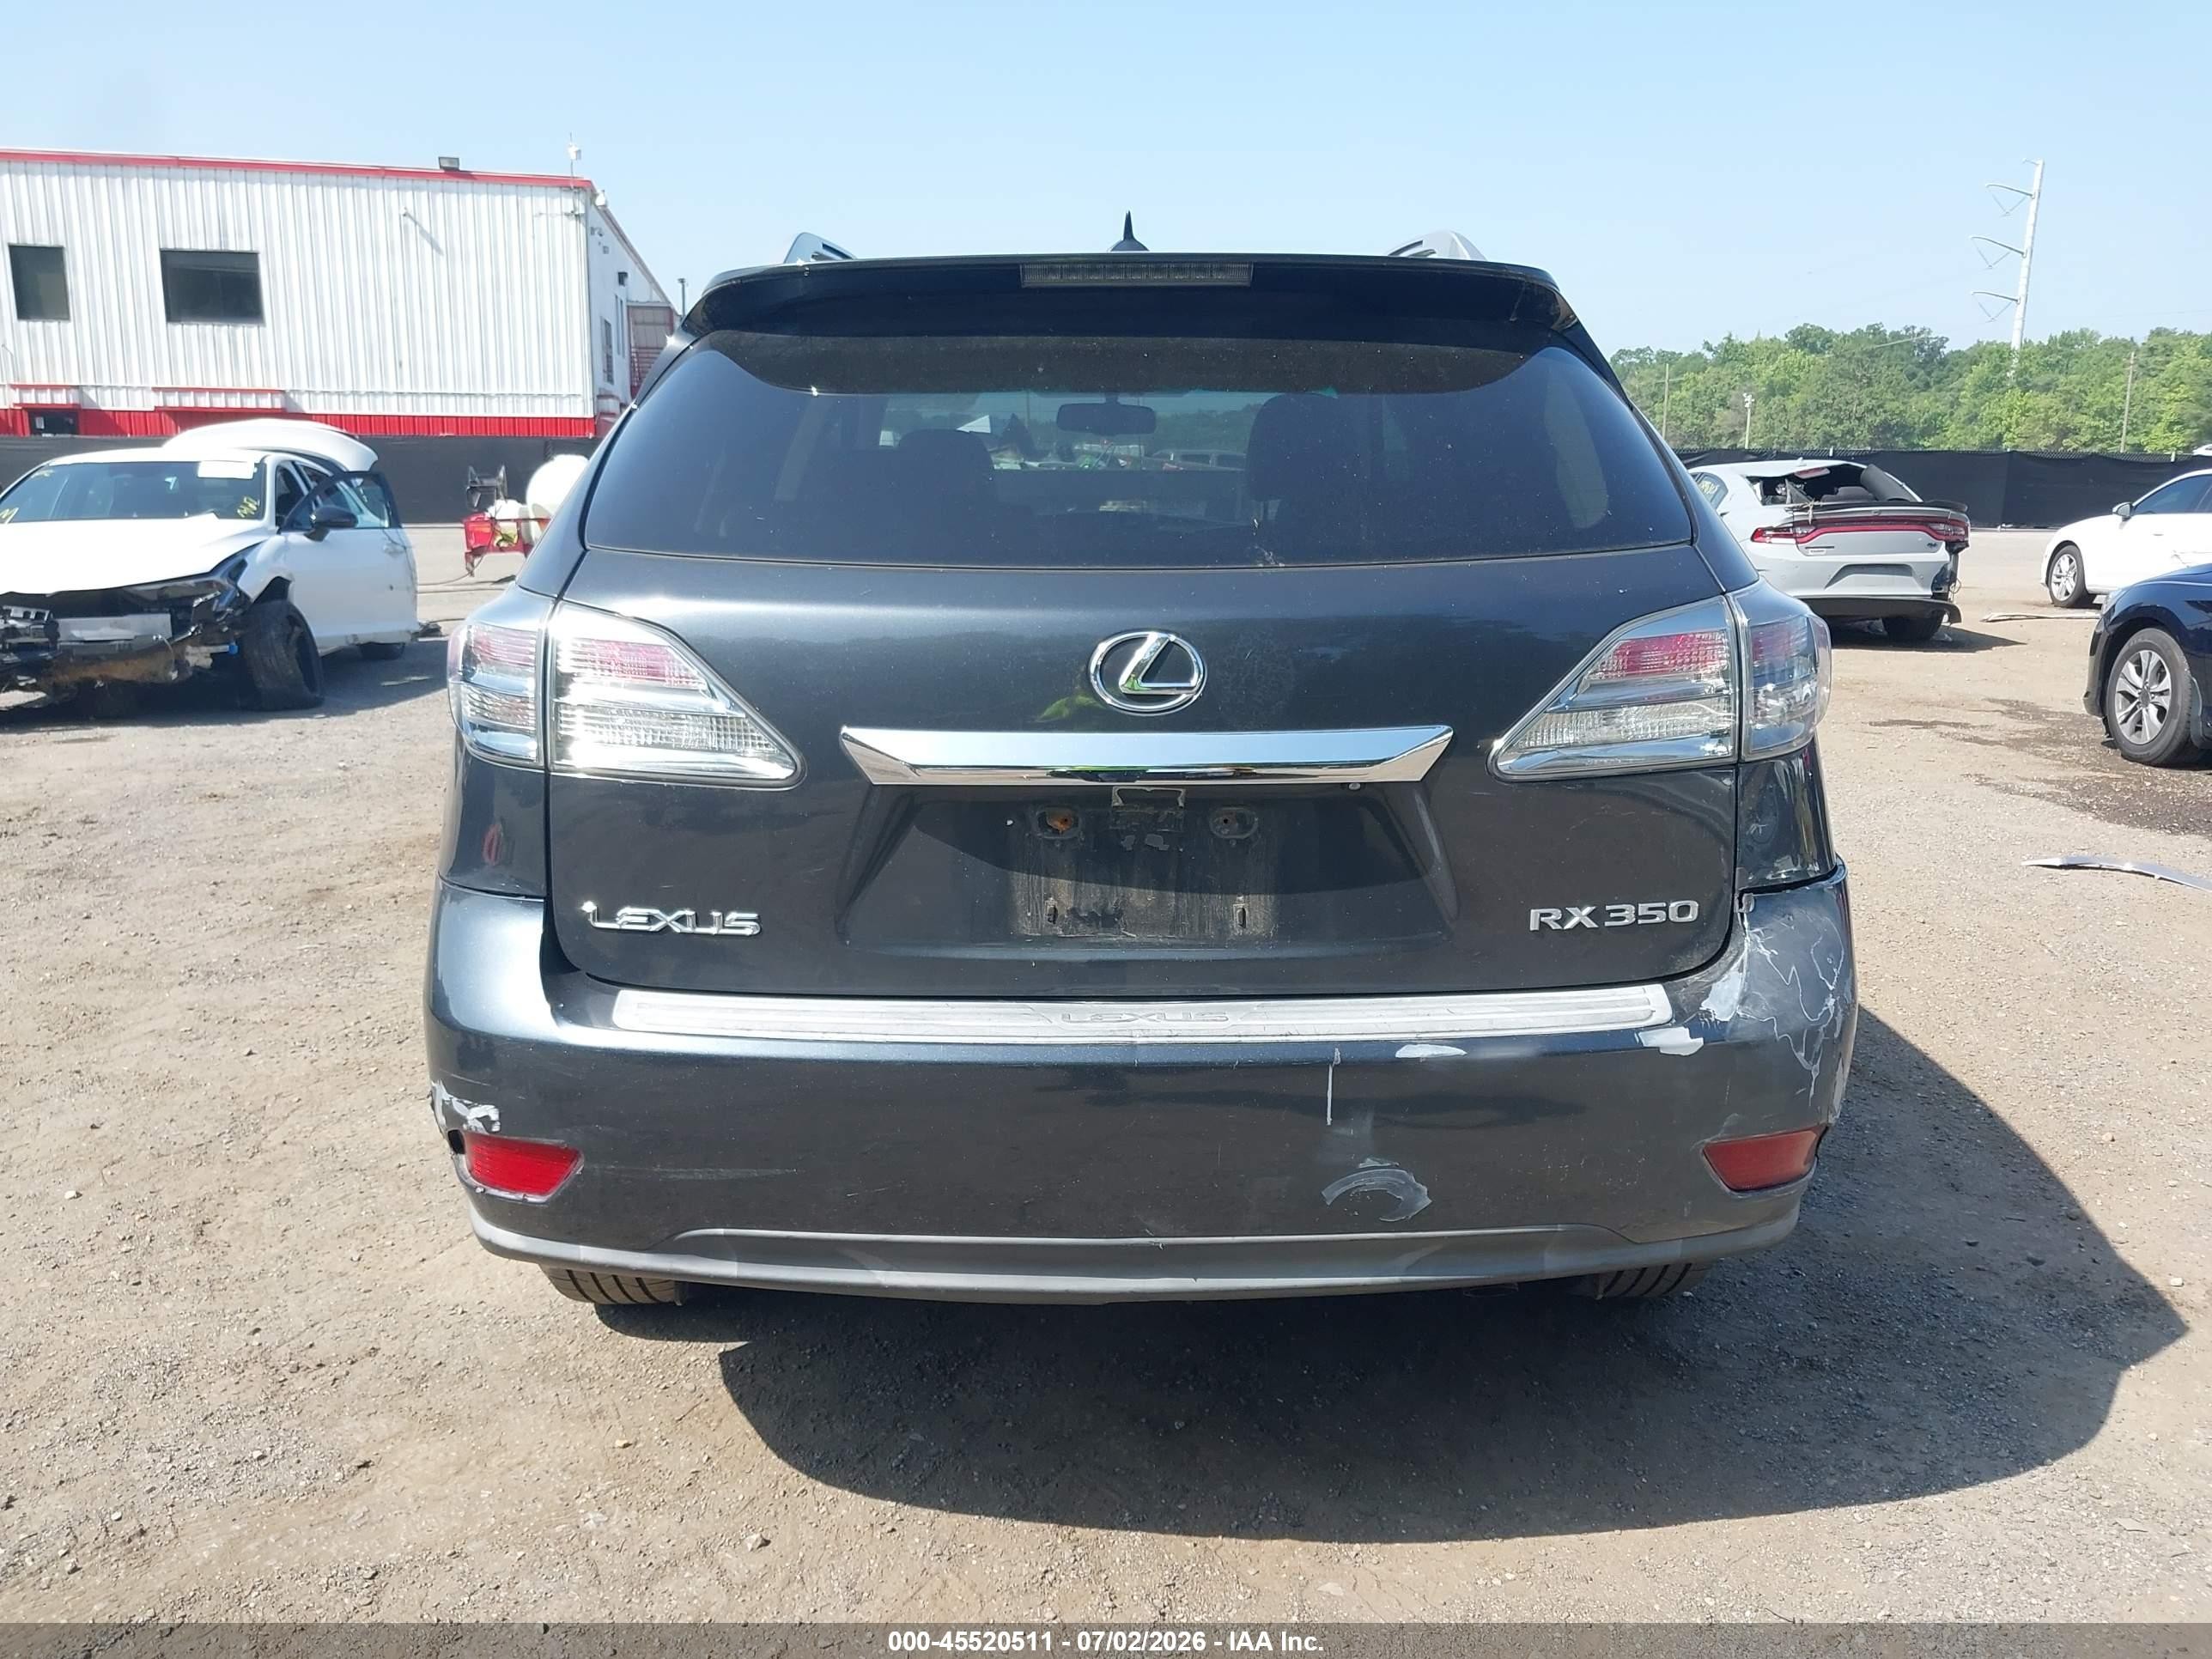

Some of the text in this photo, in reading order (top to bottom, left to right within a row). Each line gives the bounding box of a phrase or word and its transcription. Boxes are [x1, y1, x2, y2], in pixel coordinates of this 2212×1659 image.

[583, 902, 761, 936] LEXUS
[1529, 901, 1699, 931] RX 350
[1060, 1012, 1230, 1024] LEXUS
